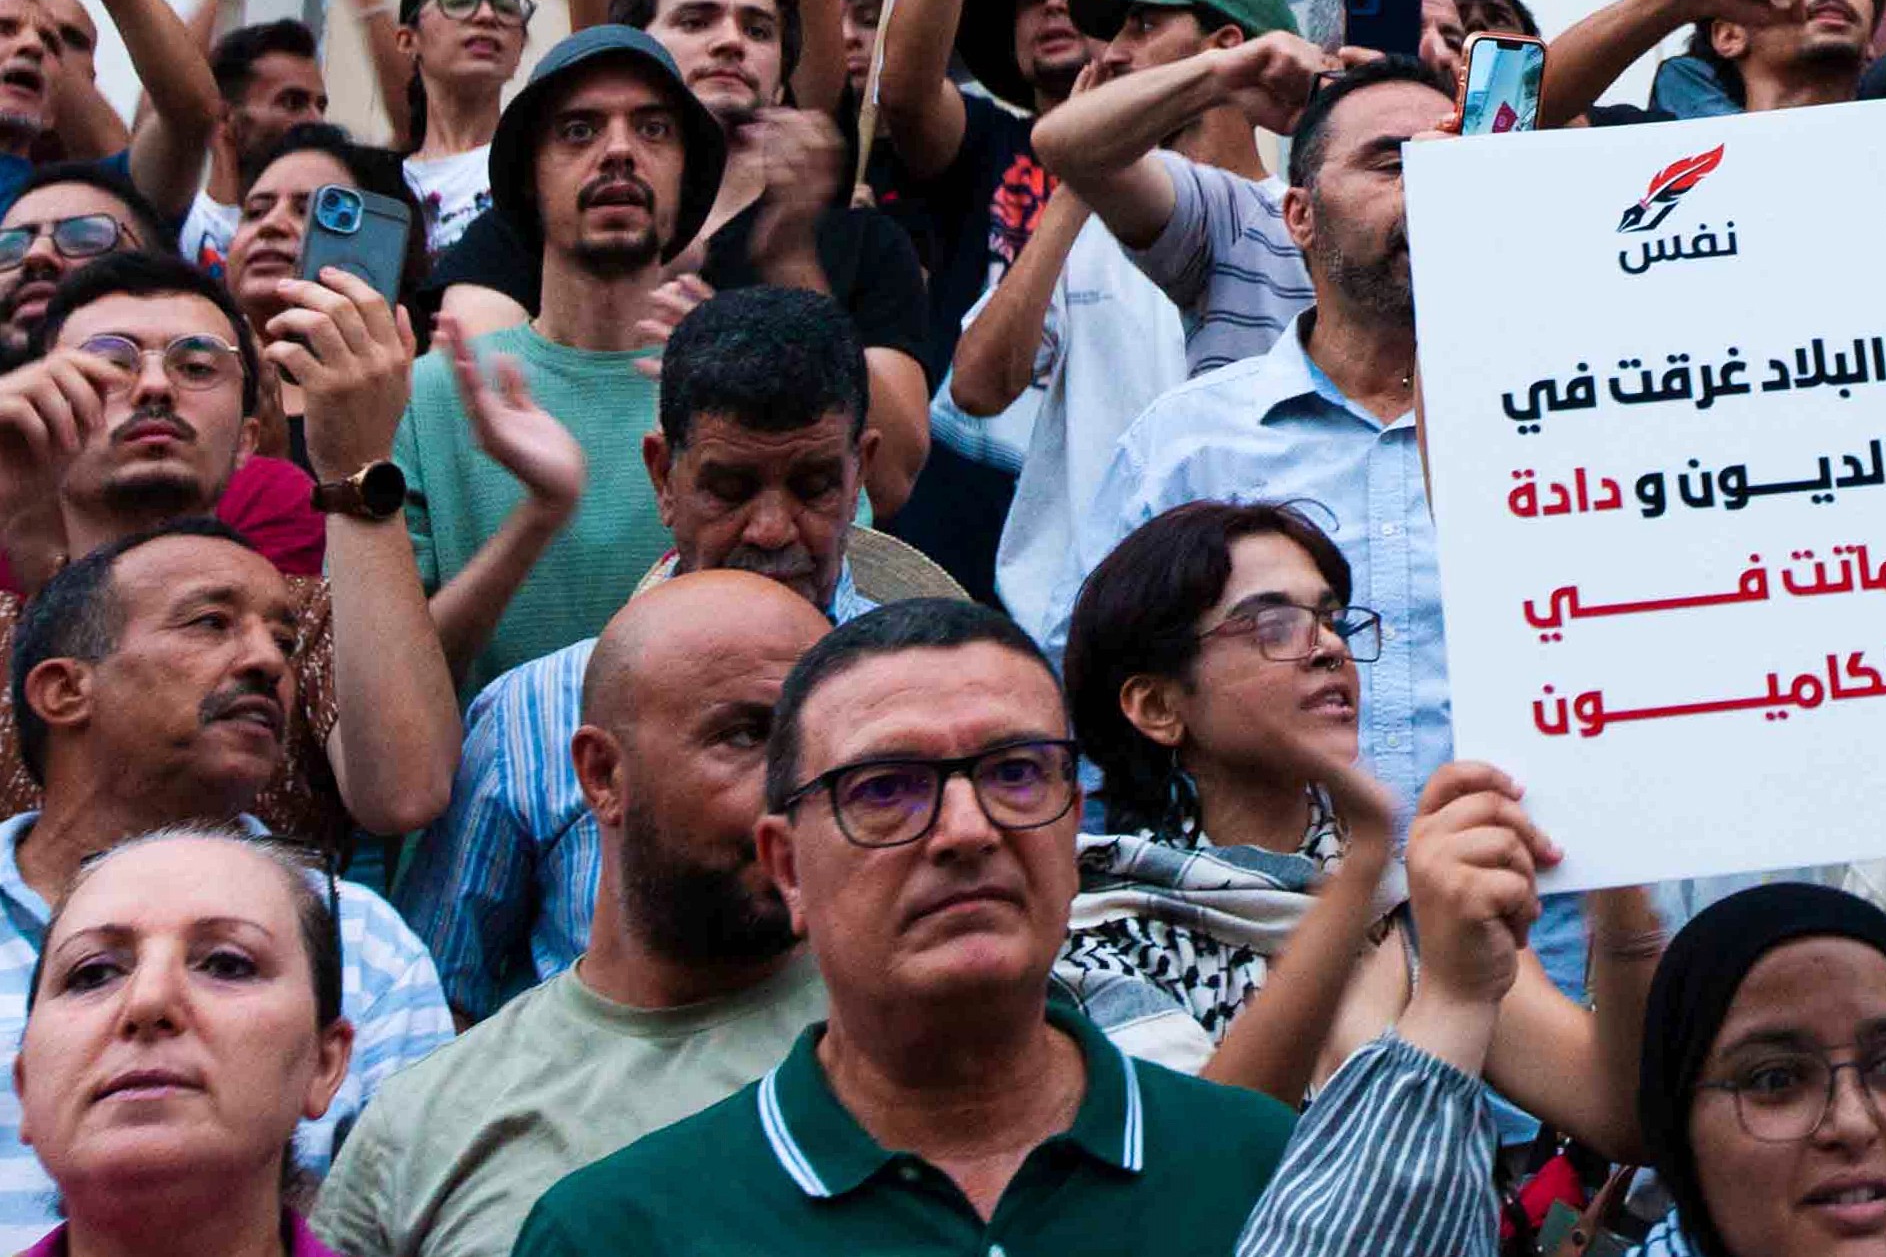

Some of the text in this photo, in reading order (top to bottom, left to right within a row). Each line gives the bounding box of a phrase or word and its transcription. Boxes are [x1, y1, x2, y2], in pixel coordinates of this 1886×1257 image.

[1618, 220, 1738, 275] نفس
[1501, 362, 1597, 435] في
[1608, 346, 1752, 410] غرقت
[1507, 467, 1624, 518] دادة
[1634, 471, 1667, 519] و
[1523, 553, 1770, 642] في
